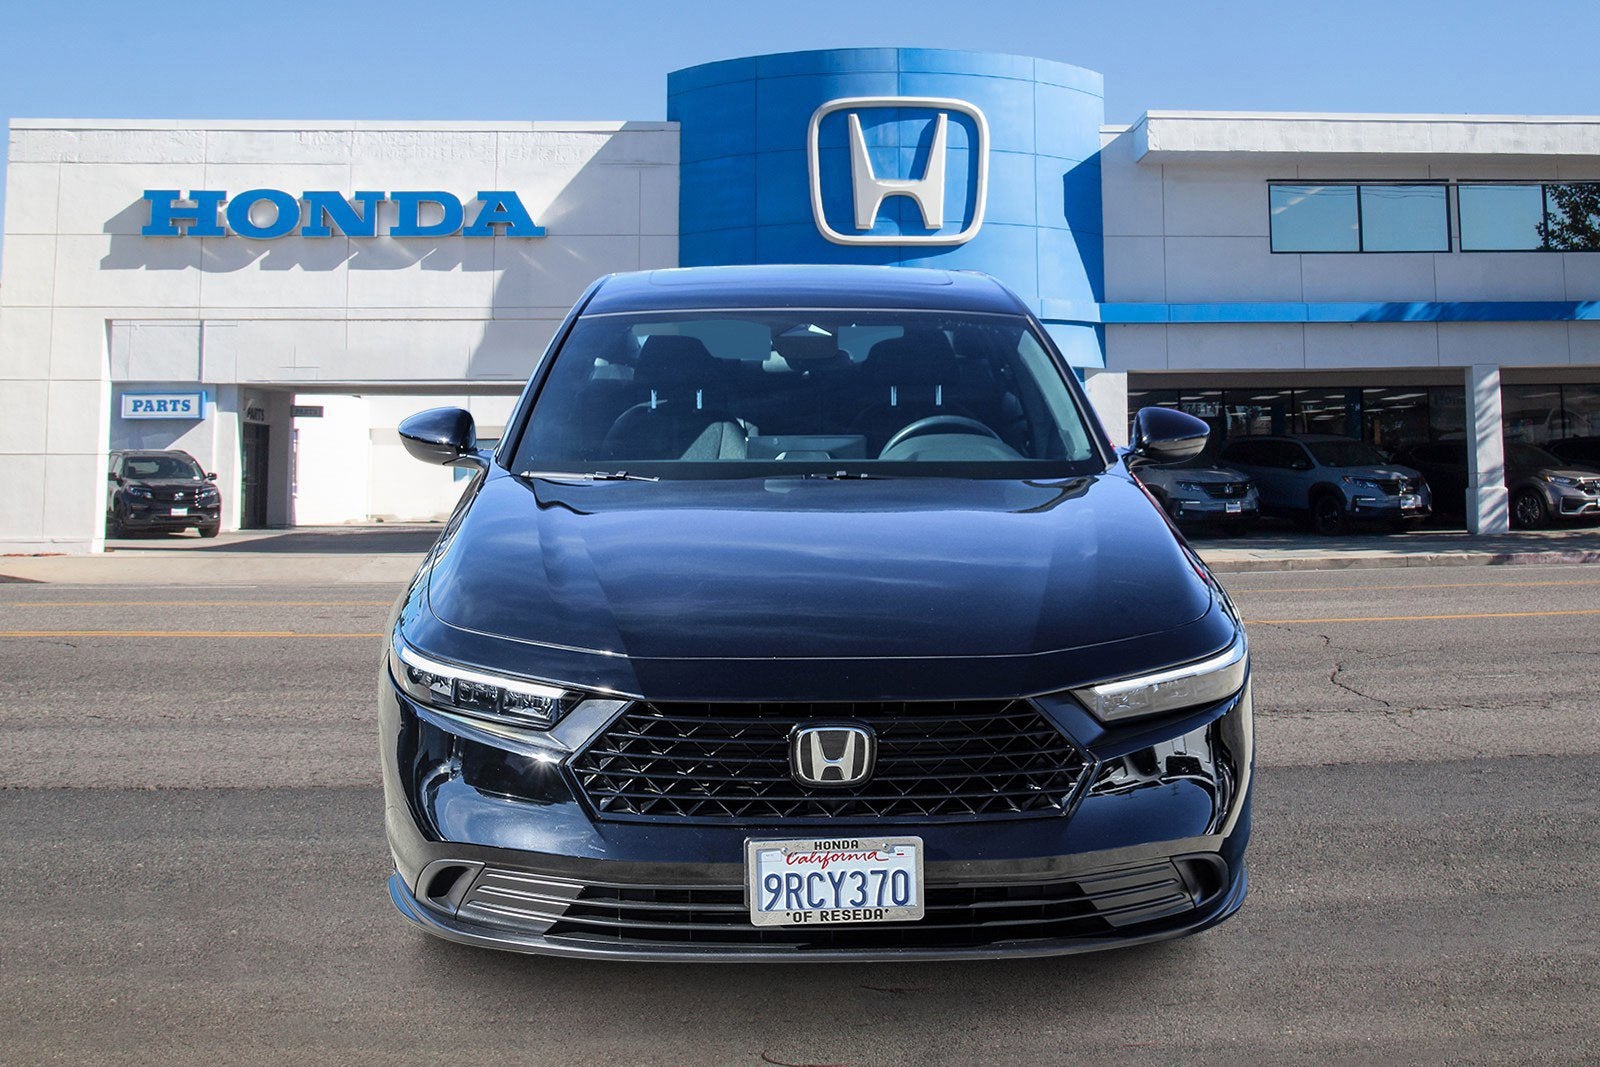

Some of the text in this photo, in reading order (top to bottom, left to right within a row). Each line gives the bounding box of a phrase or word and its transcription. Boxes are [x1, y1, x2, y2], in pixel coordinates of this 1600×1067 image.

[142, 189, 547, 238] HONDA
[132, 400, 191, 412] PARTS
[814, 840, 858, 850] HONDA
[786, 851, 889, 869] California
[764, 870, 909, 911] 9RCY370
